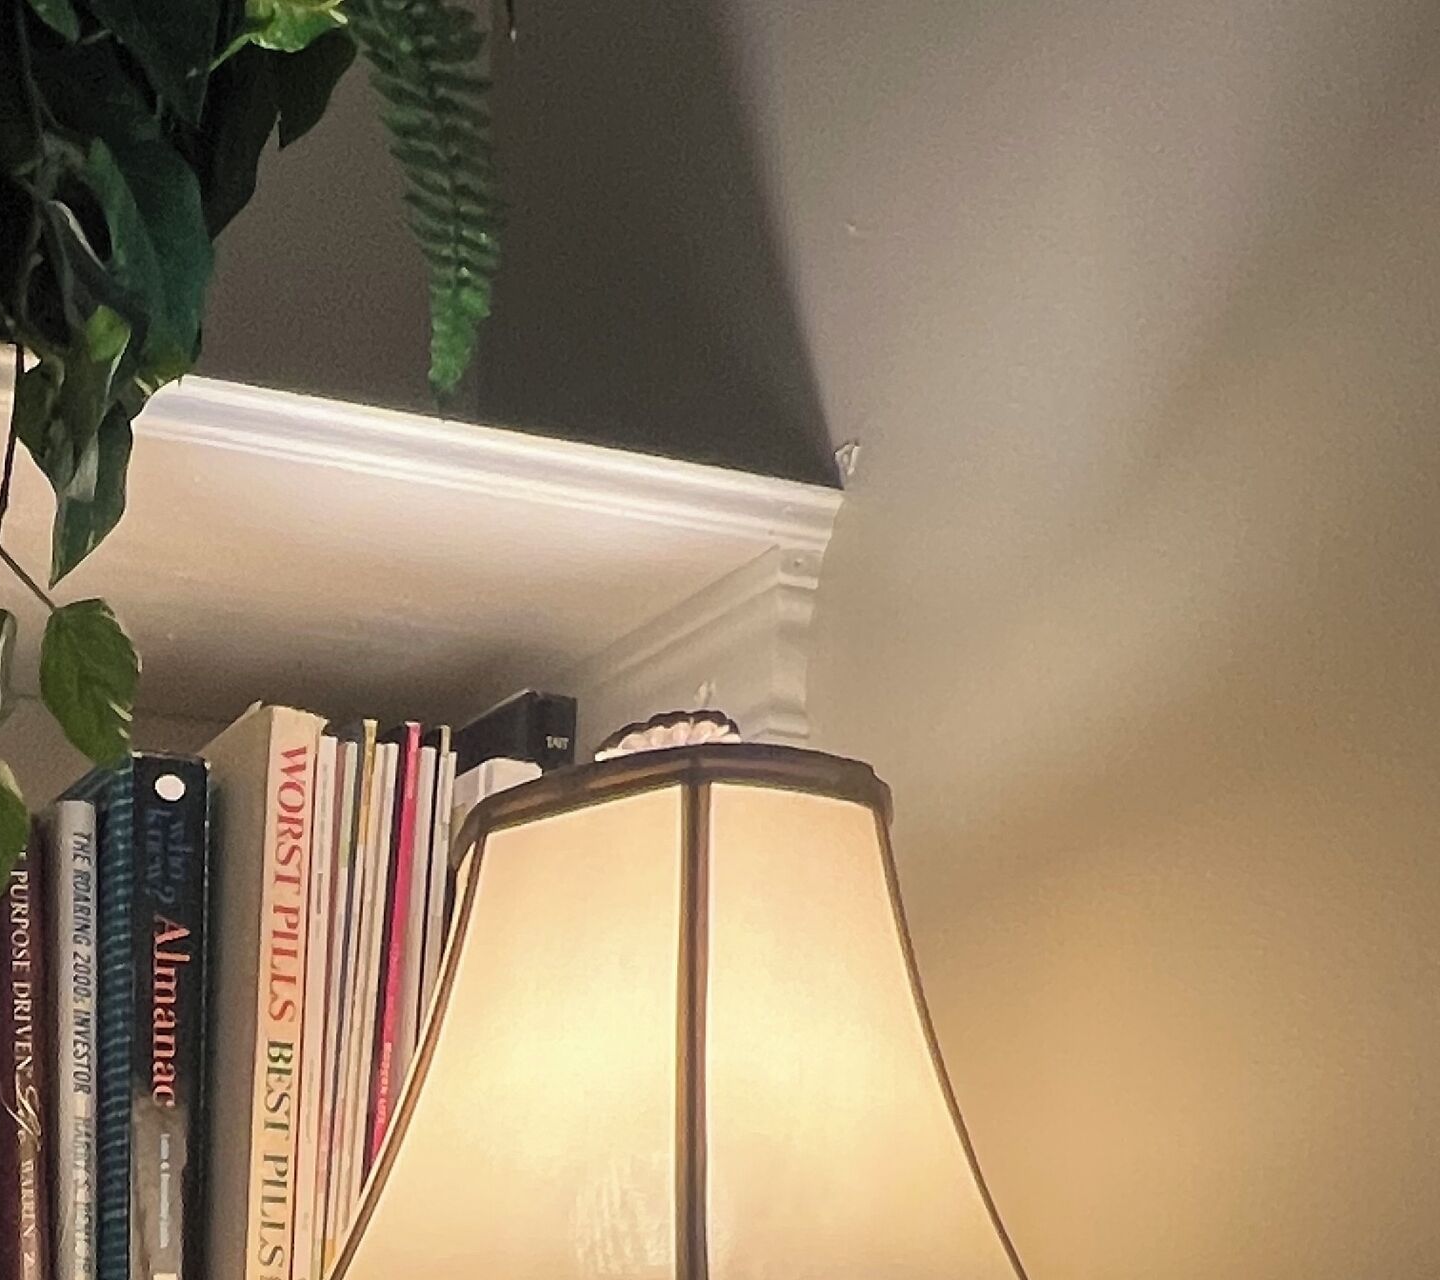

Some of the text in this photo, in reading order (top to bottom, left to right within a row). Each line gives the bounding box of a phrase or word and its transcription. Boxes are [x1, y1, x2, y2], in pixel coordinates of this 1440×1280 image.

[73, 832, 93, 863] THE
[273, 746, 308, 883] WORST
[9, 870, 34, 973] PURPOSE
[73, 868, 92, 945] ROARING
[152, 913, 192, 1108] Almanac
[268, 903, 301, 1022] PILLS
[13, 981, 35, 1078] DRIVEN
[73, 1008, 91, 1095] INVESTOR
[263, 1038, 295, 1140] BEST
[257, 1152, 290, 1267] PILLS
